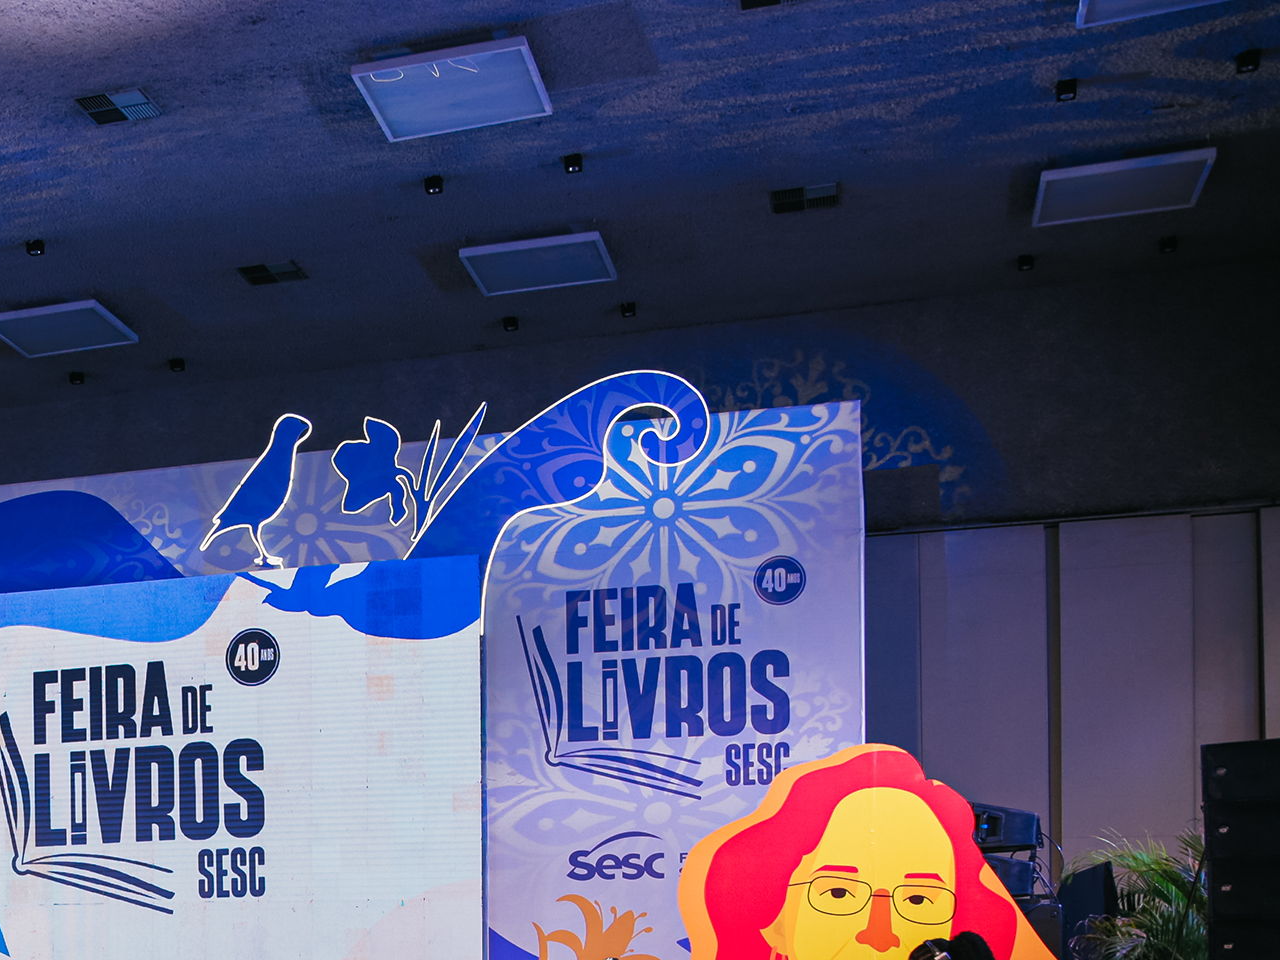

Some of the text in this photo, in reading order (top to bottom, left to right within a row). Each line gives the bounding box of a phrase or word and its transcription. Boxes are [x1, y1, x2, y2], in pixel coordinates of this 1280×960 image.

[762, 568, 786, 592] 40
[565, 582, 741, 654] FEIRA DE
[234, 642, 259, 671] 40
[33, 661, 213, 744] FEIRA DE
[725, 742, 790, 786] SESC
[197, 847, 266, 899] SESC
[567, 831, 665, 881] Sesc
